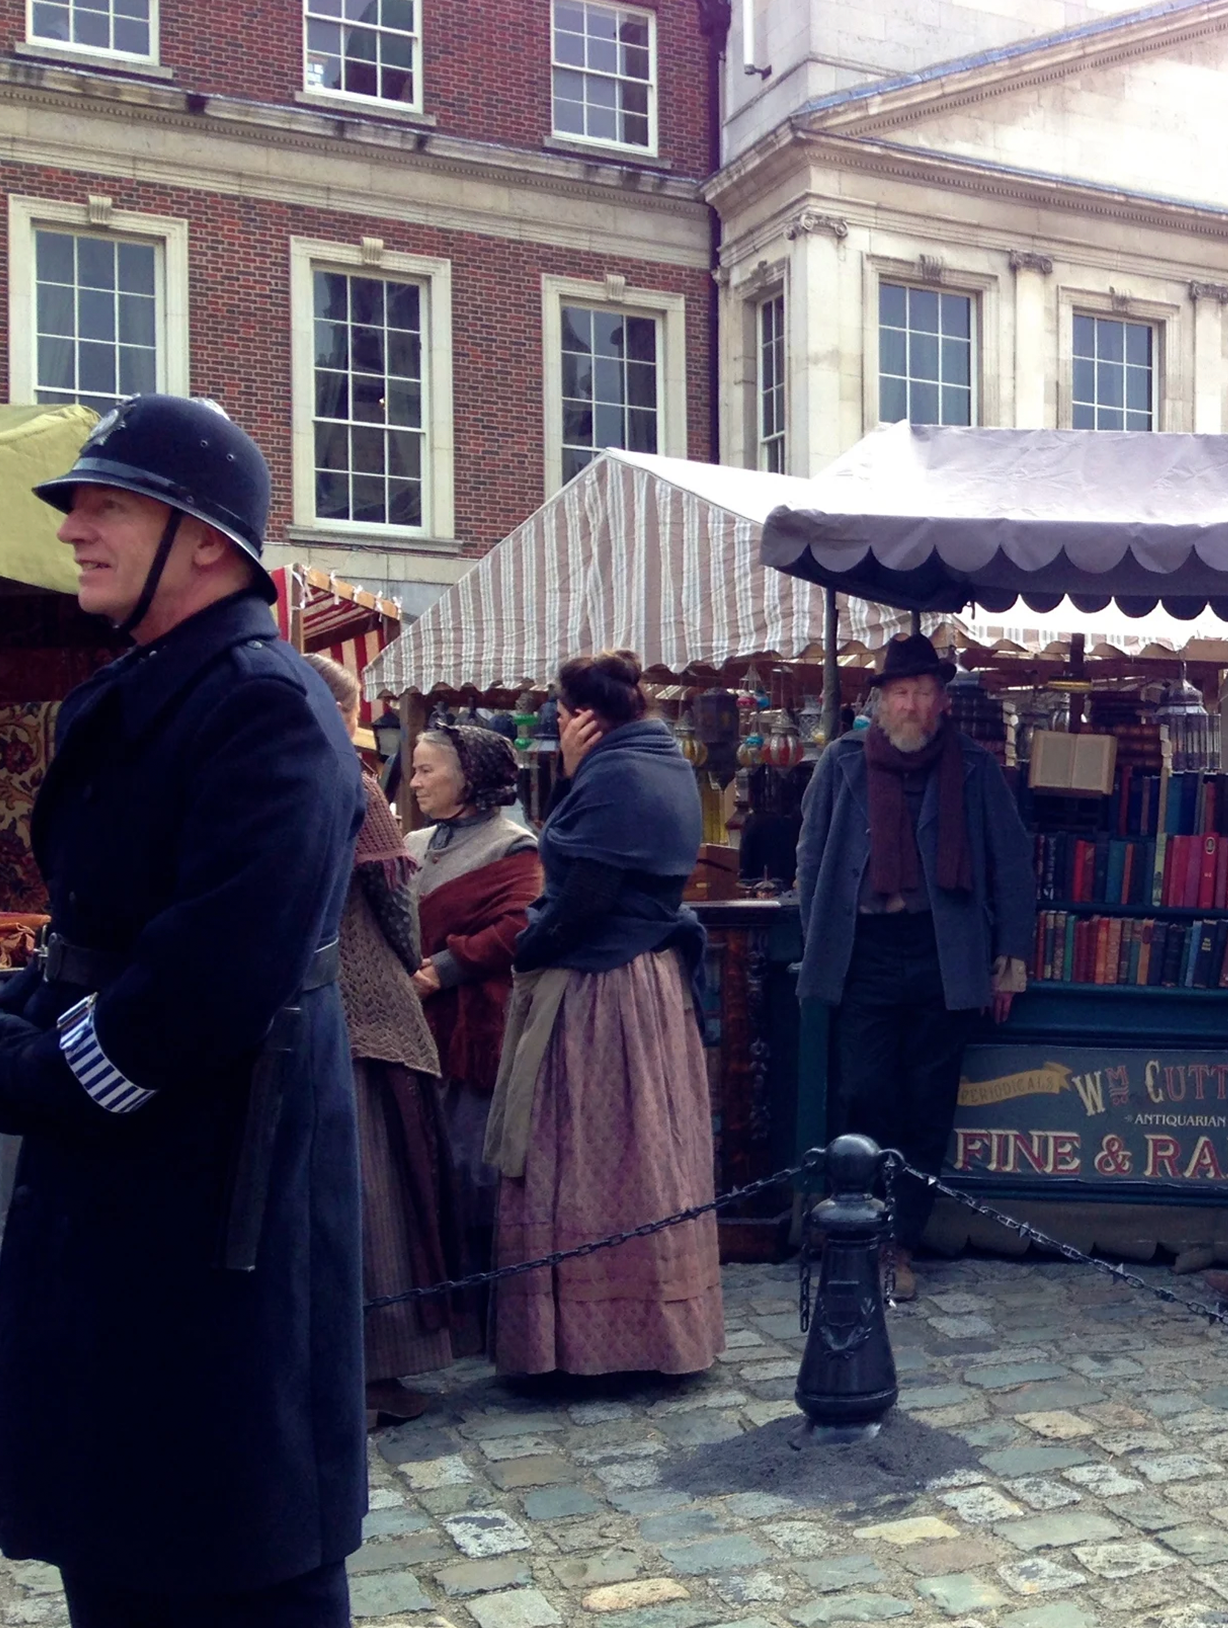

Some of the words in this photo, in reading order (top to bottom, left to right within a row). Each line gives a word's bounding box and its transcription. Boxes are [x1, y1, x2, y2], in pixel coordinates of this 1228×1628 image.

[960, 1076, 1054, 1103] PERIODICALS
[1134, 1113, 1226, 1128] ANTIQUARIAN
[953, 1128, 1081, 1175] FINE
[1094, 1134, 1132, 1176] &
